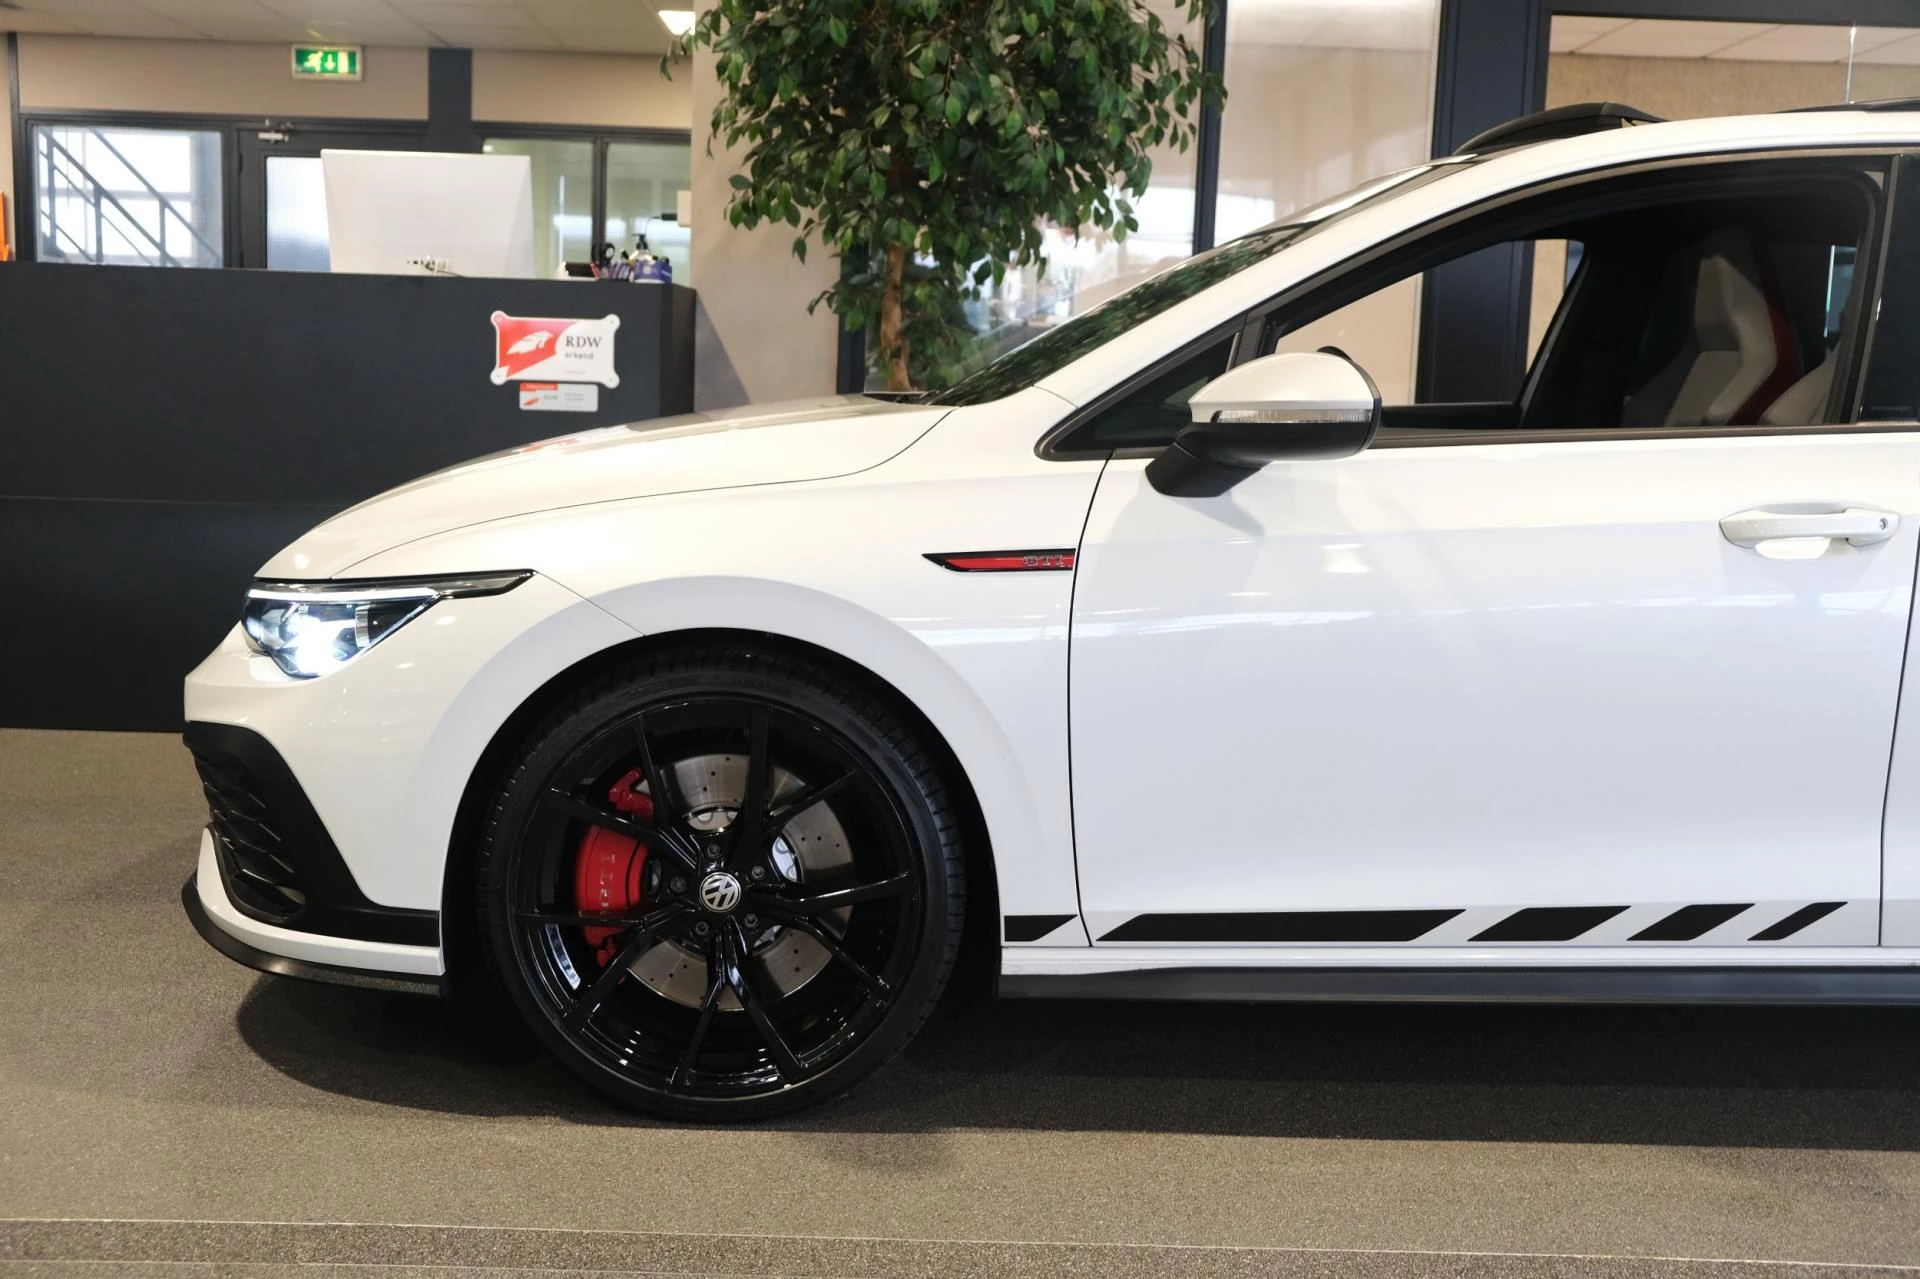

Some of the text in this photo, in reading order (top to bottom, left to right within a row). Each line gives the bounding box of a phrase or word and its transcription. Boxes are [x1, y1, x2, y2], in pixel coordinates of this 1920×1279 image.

[565, 335, 602, 348] RDW
[564, 351, 594, 360] erkend
[1023, 554, 1064, 568] GTI
